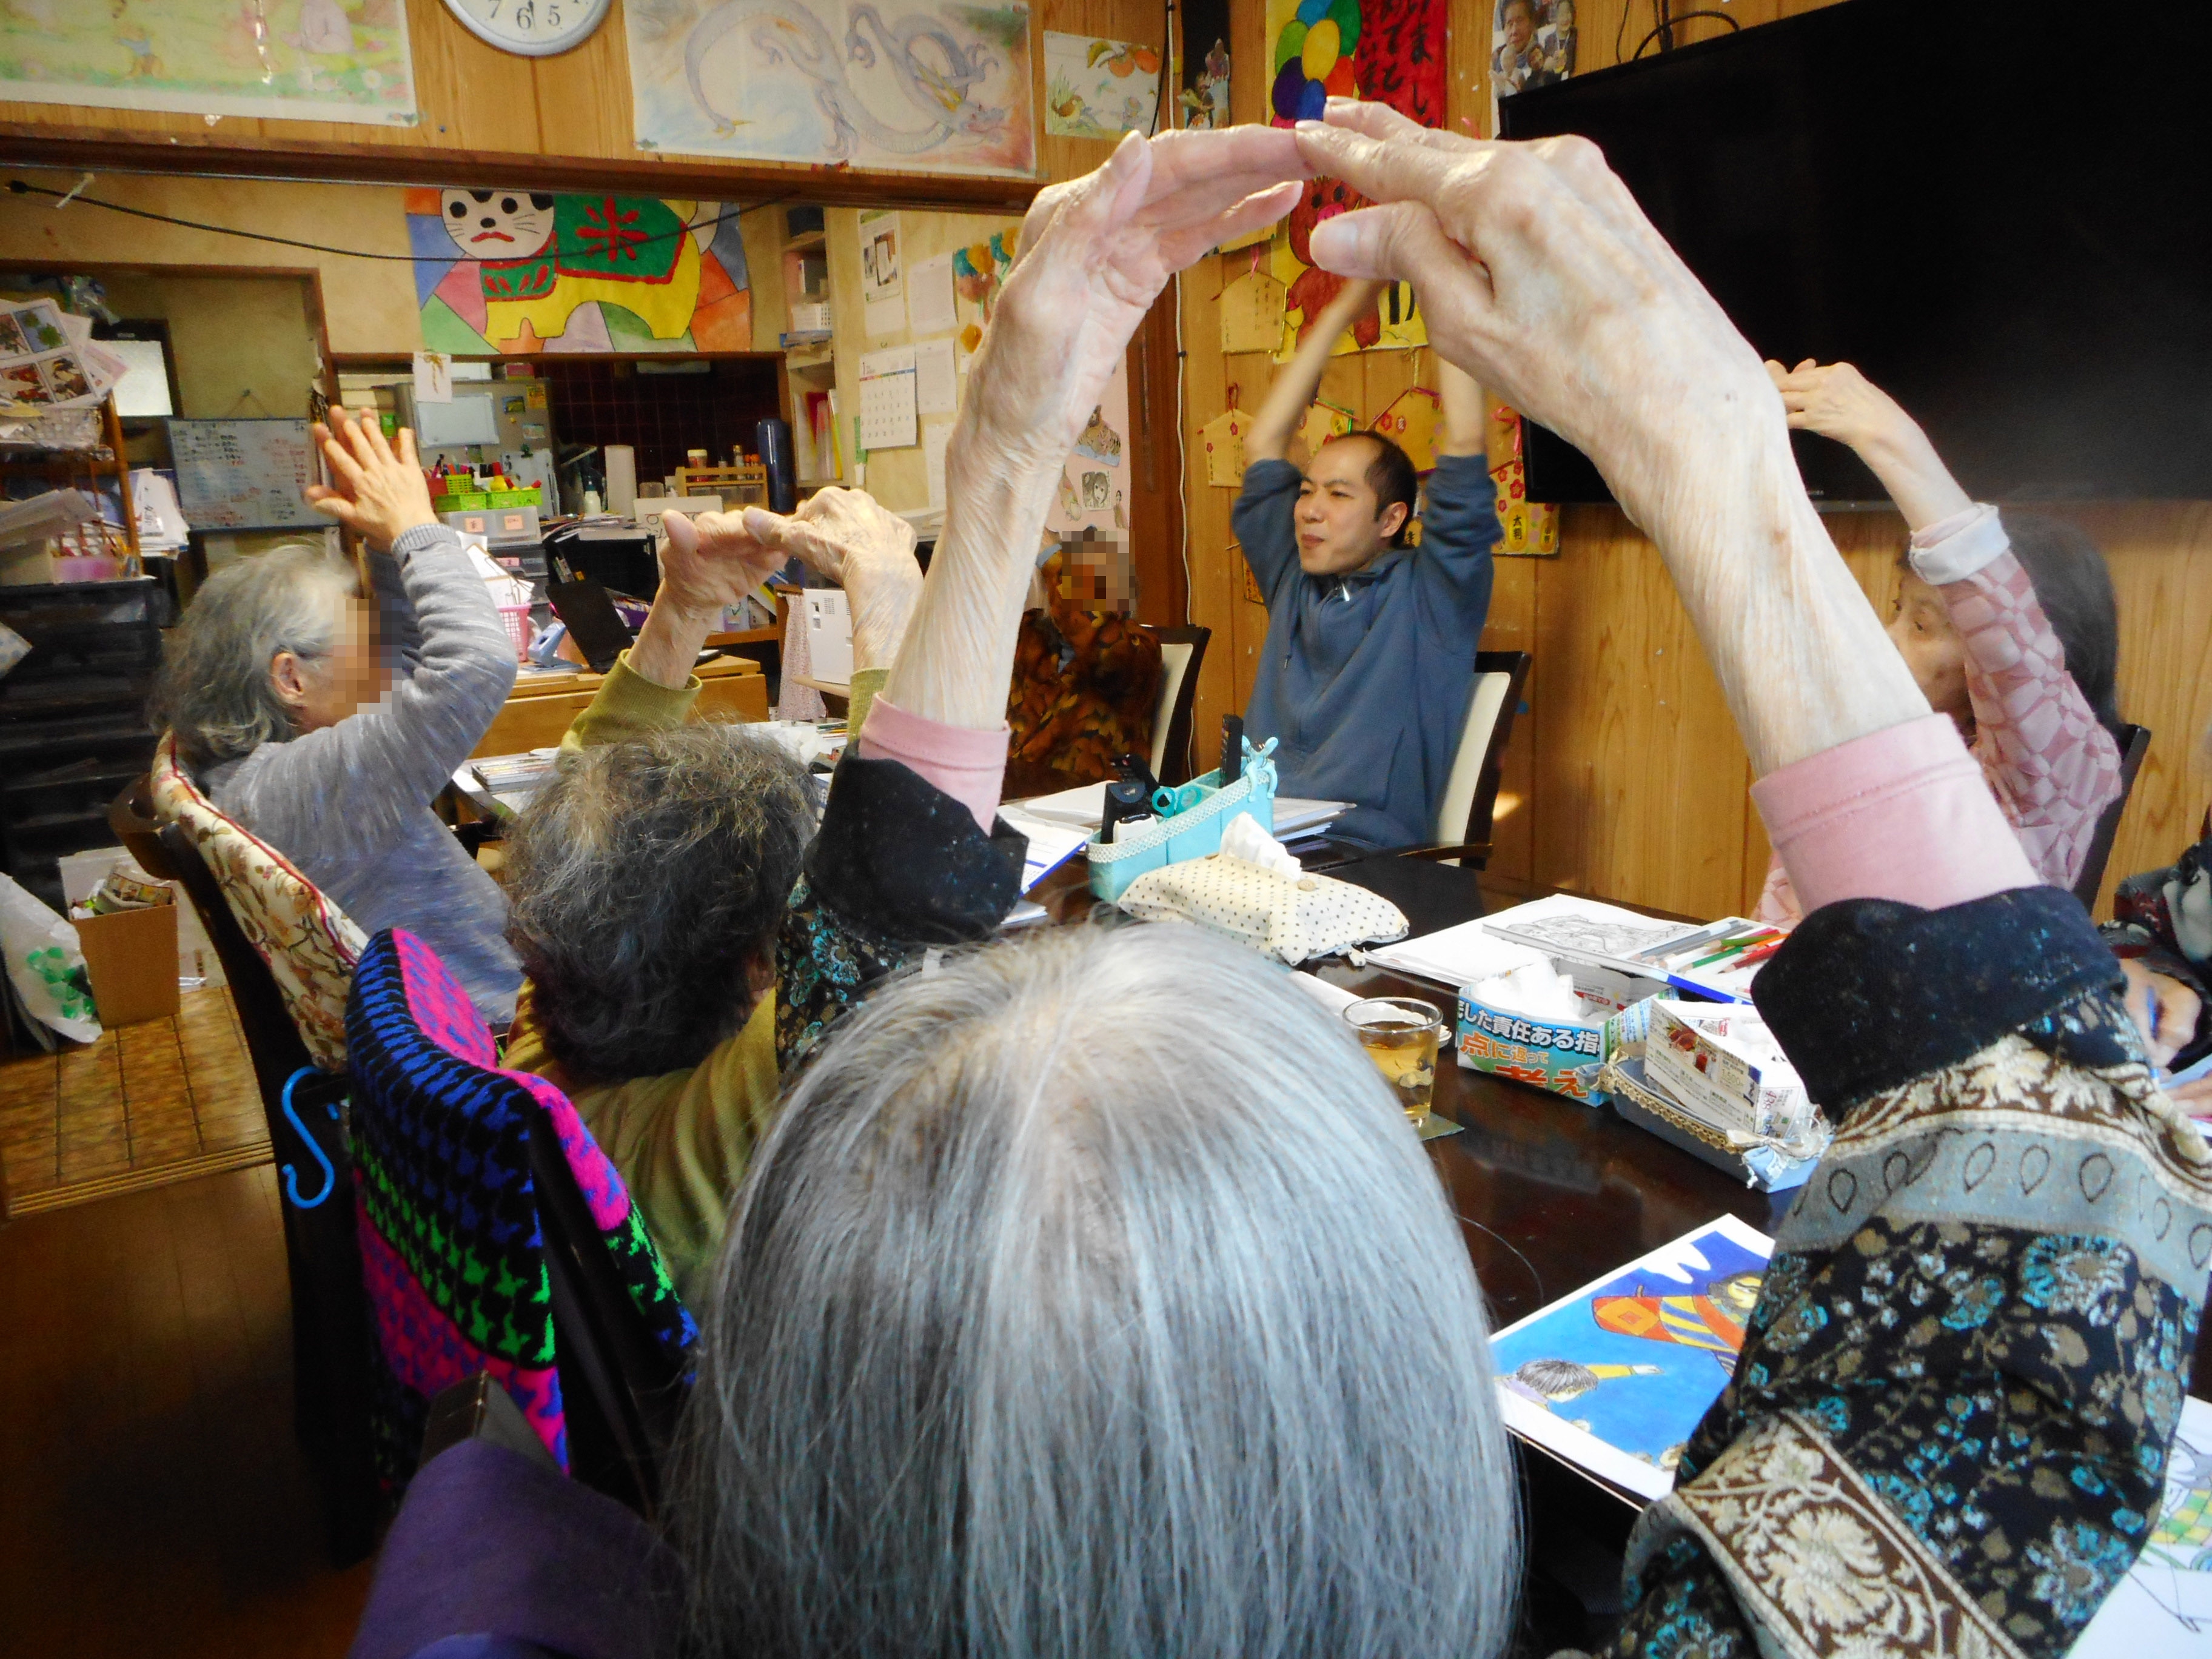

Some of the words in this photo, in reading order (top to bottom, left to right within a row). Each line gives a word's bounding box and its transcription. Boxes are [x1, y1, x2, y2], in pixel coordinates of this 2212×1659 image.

[517, 7, 531, 29] 6
[548, 5, 560, 26] 5
[1458, 1000, 1600, 1055] した責任ある指
[1460, 1031, 1549, 1064] 点に返って
